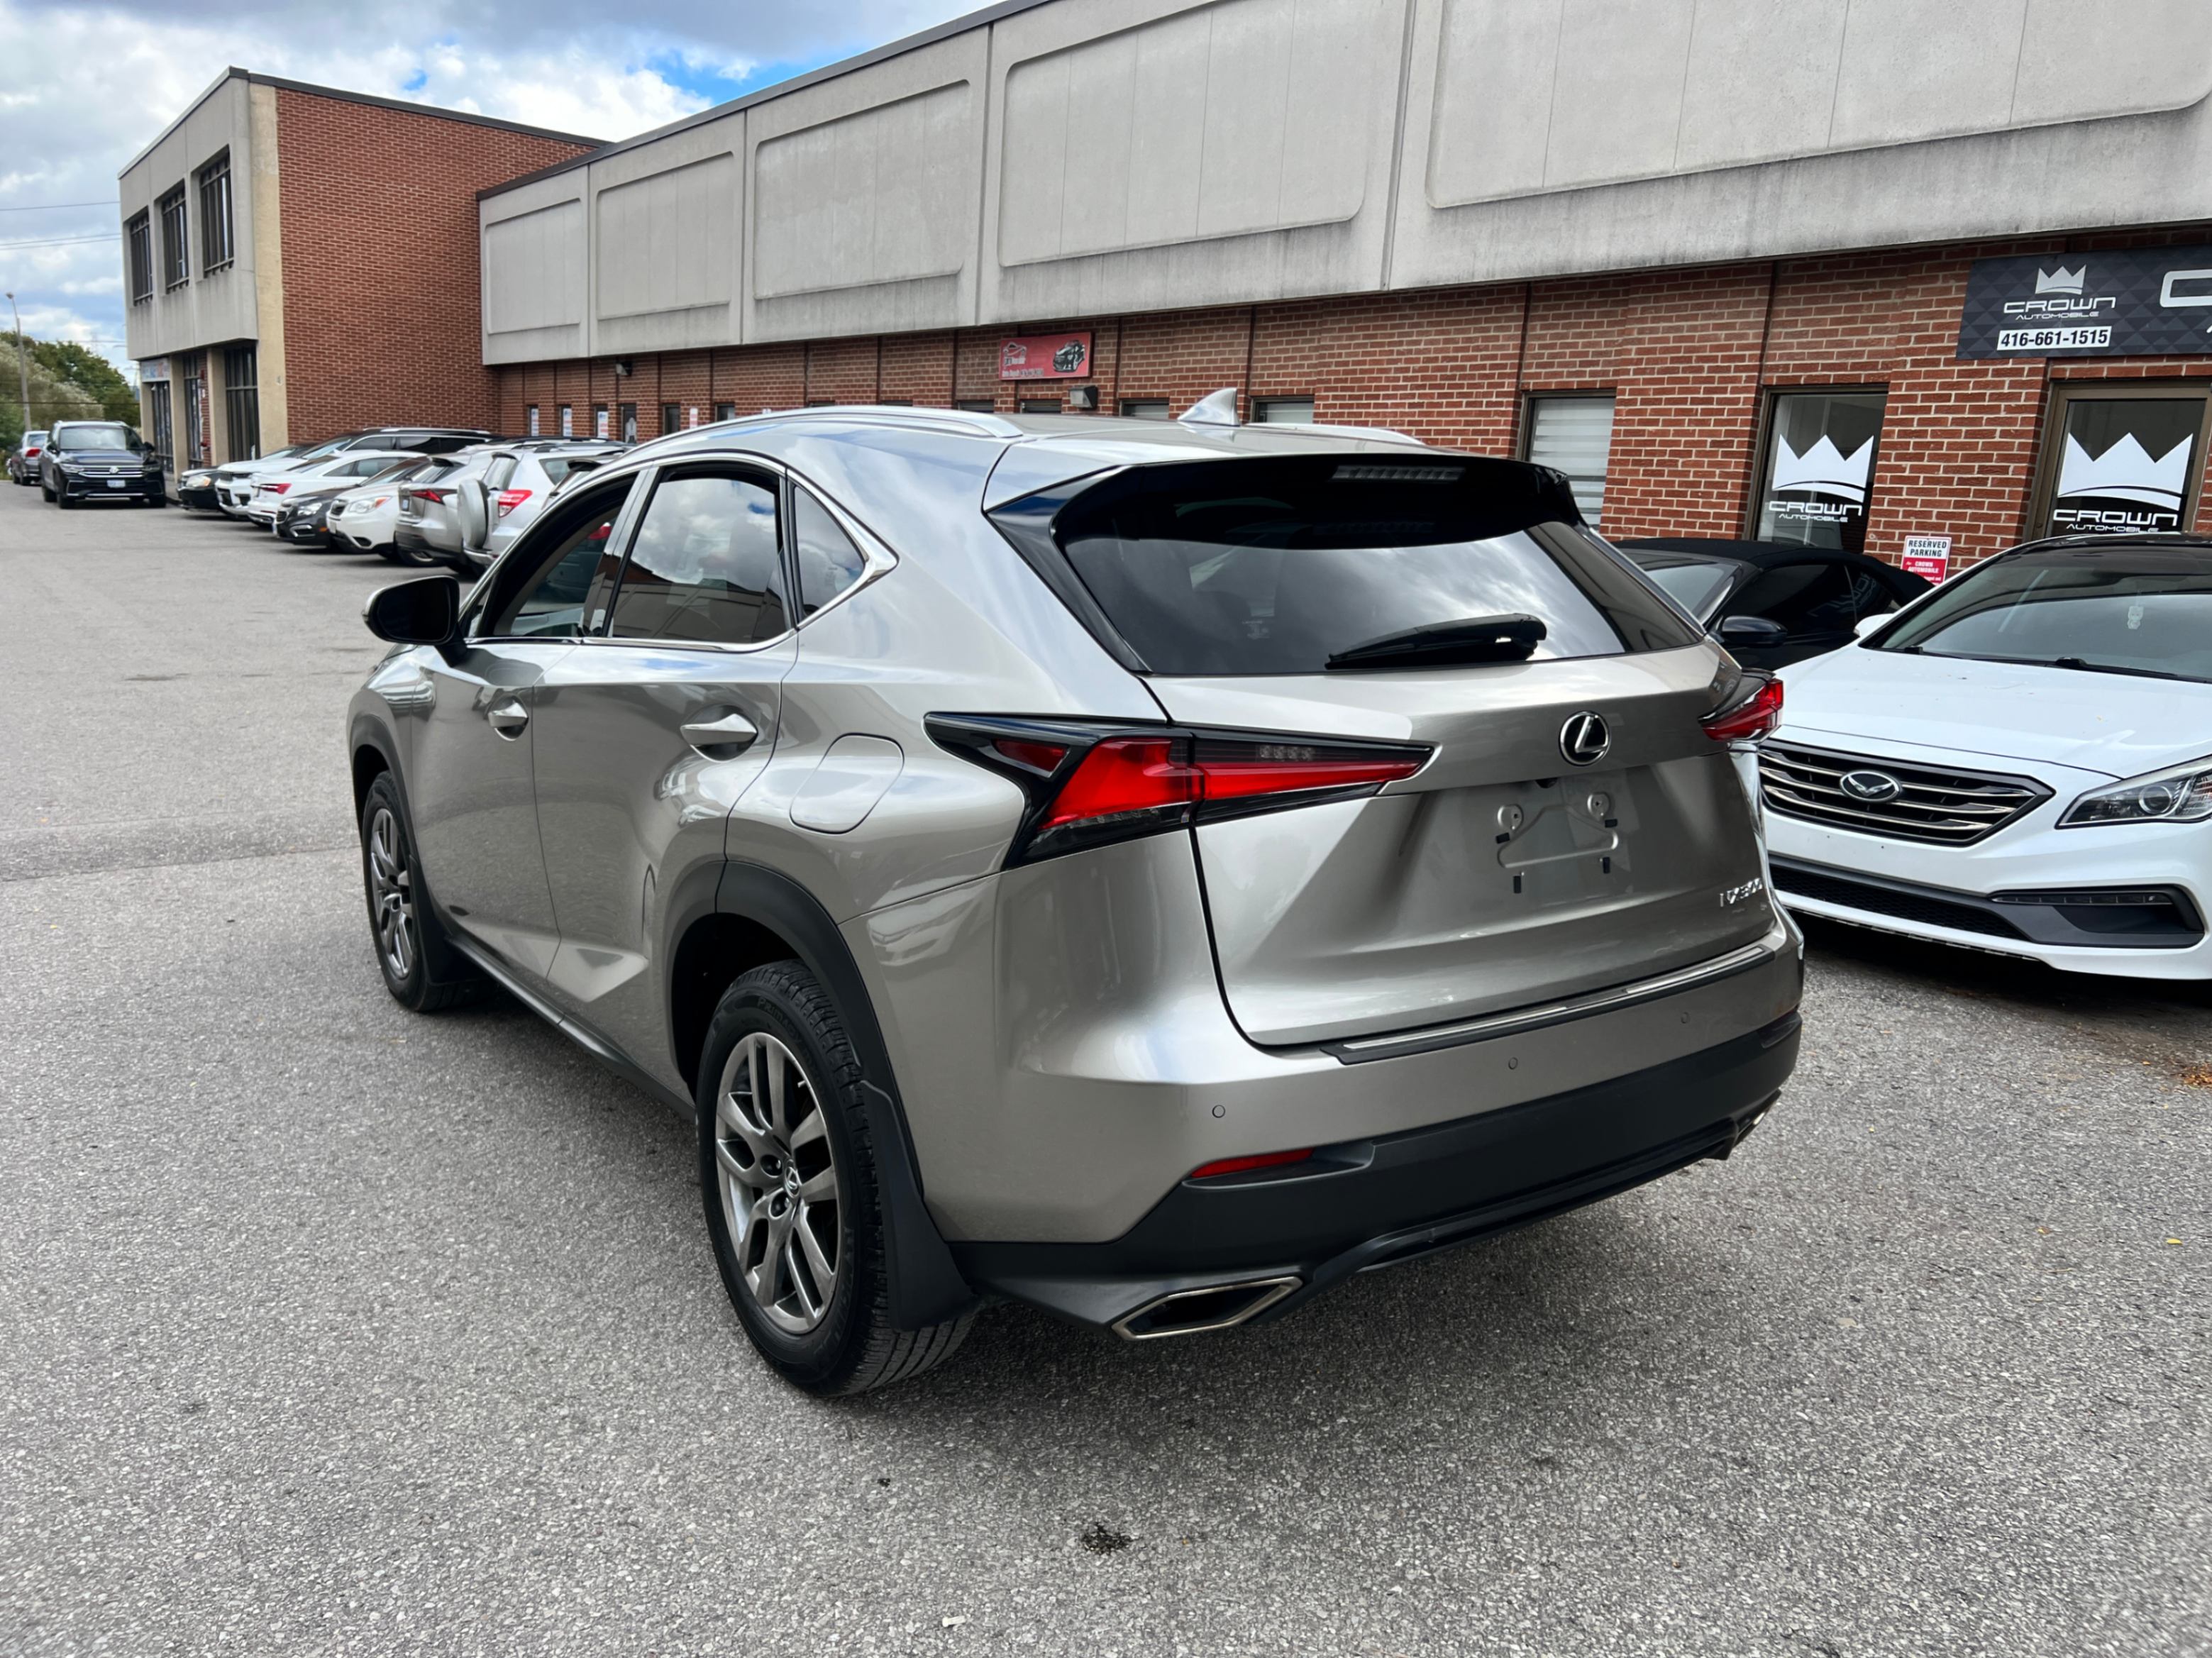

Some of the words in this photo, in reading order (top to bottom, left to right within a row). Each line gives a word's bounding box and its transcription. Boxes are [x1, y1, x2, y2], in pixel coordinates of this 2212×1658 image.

[2003, 297, 2117, 314] CROWN
[2015, 311, 2100, 321] AUTOMOBILE
[2001, 329, 2108, 347] 416-661-1515
[1769, 500, 1863, 516] CROWN
[1779, 513, 1849, 523] AUTOMOBILE
[2052, 509, 2179, 526] CROWN
[2066, 523, 2160, 533] AUTOMOBILE
[1908, 540, 1947, 548] RESERVED
[1910, 548, 1942, 557] PARKING
